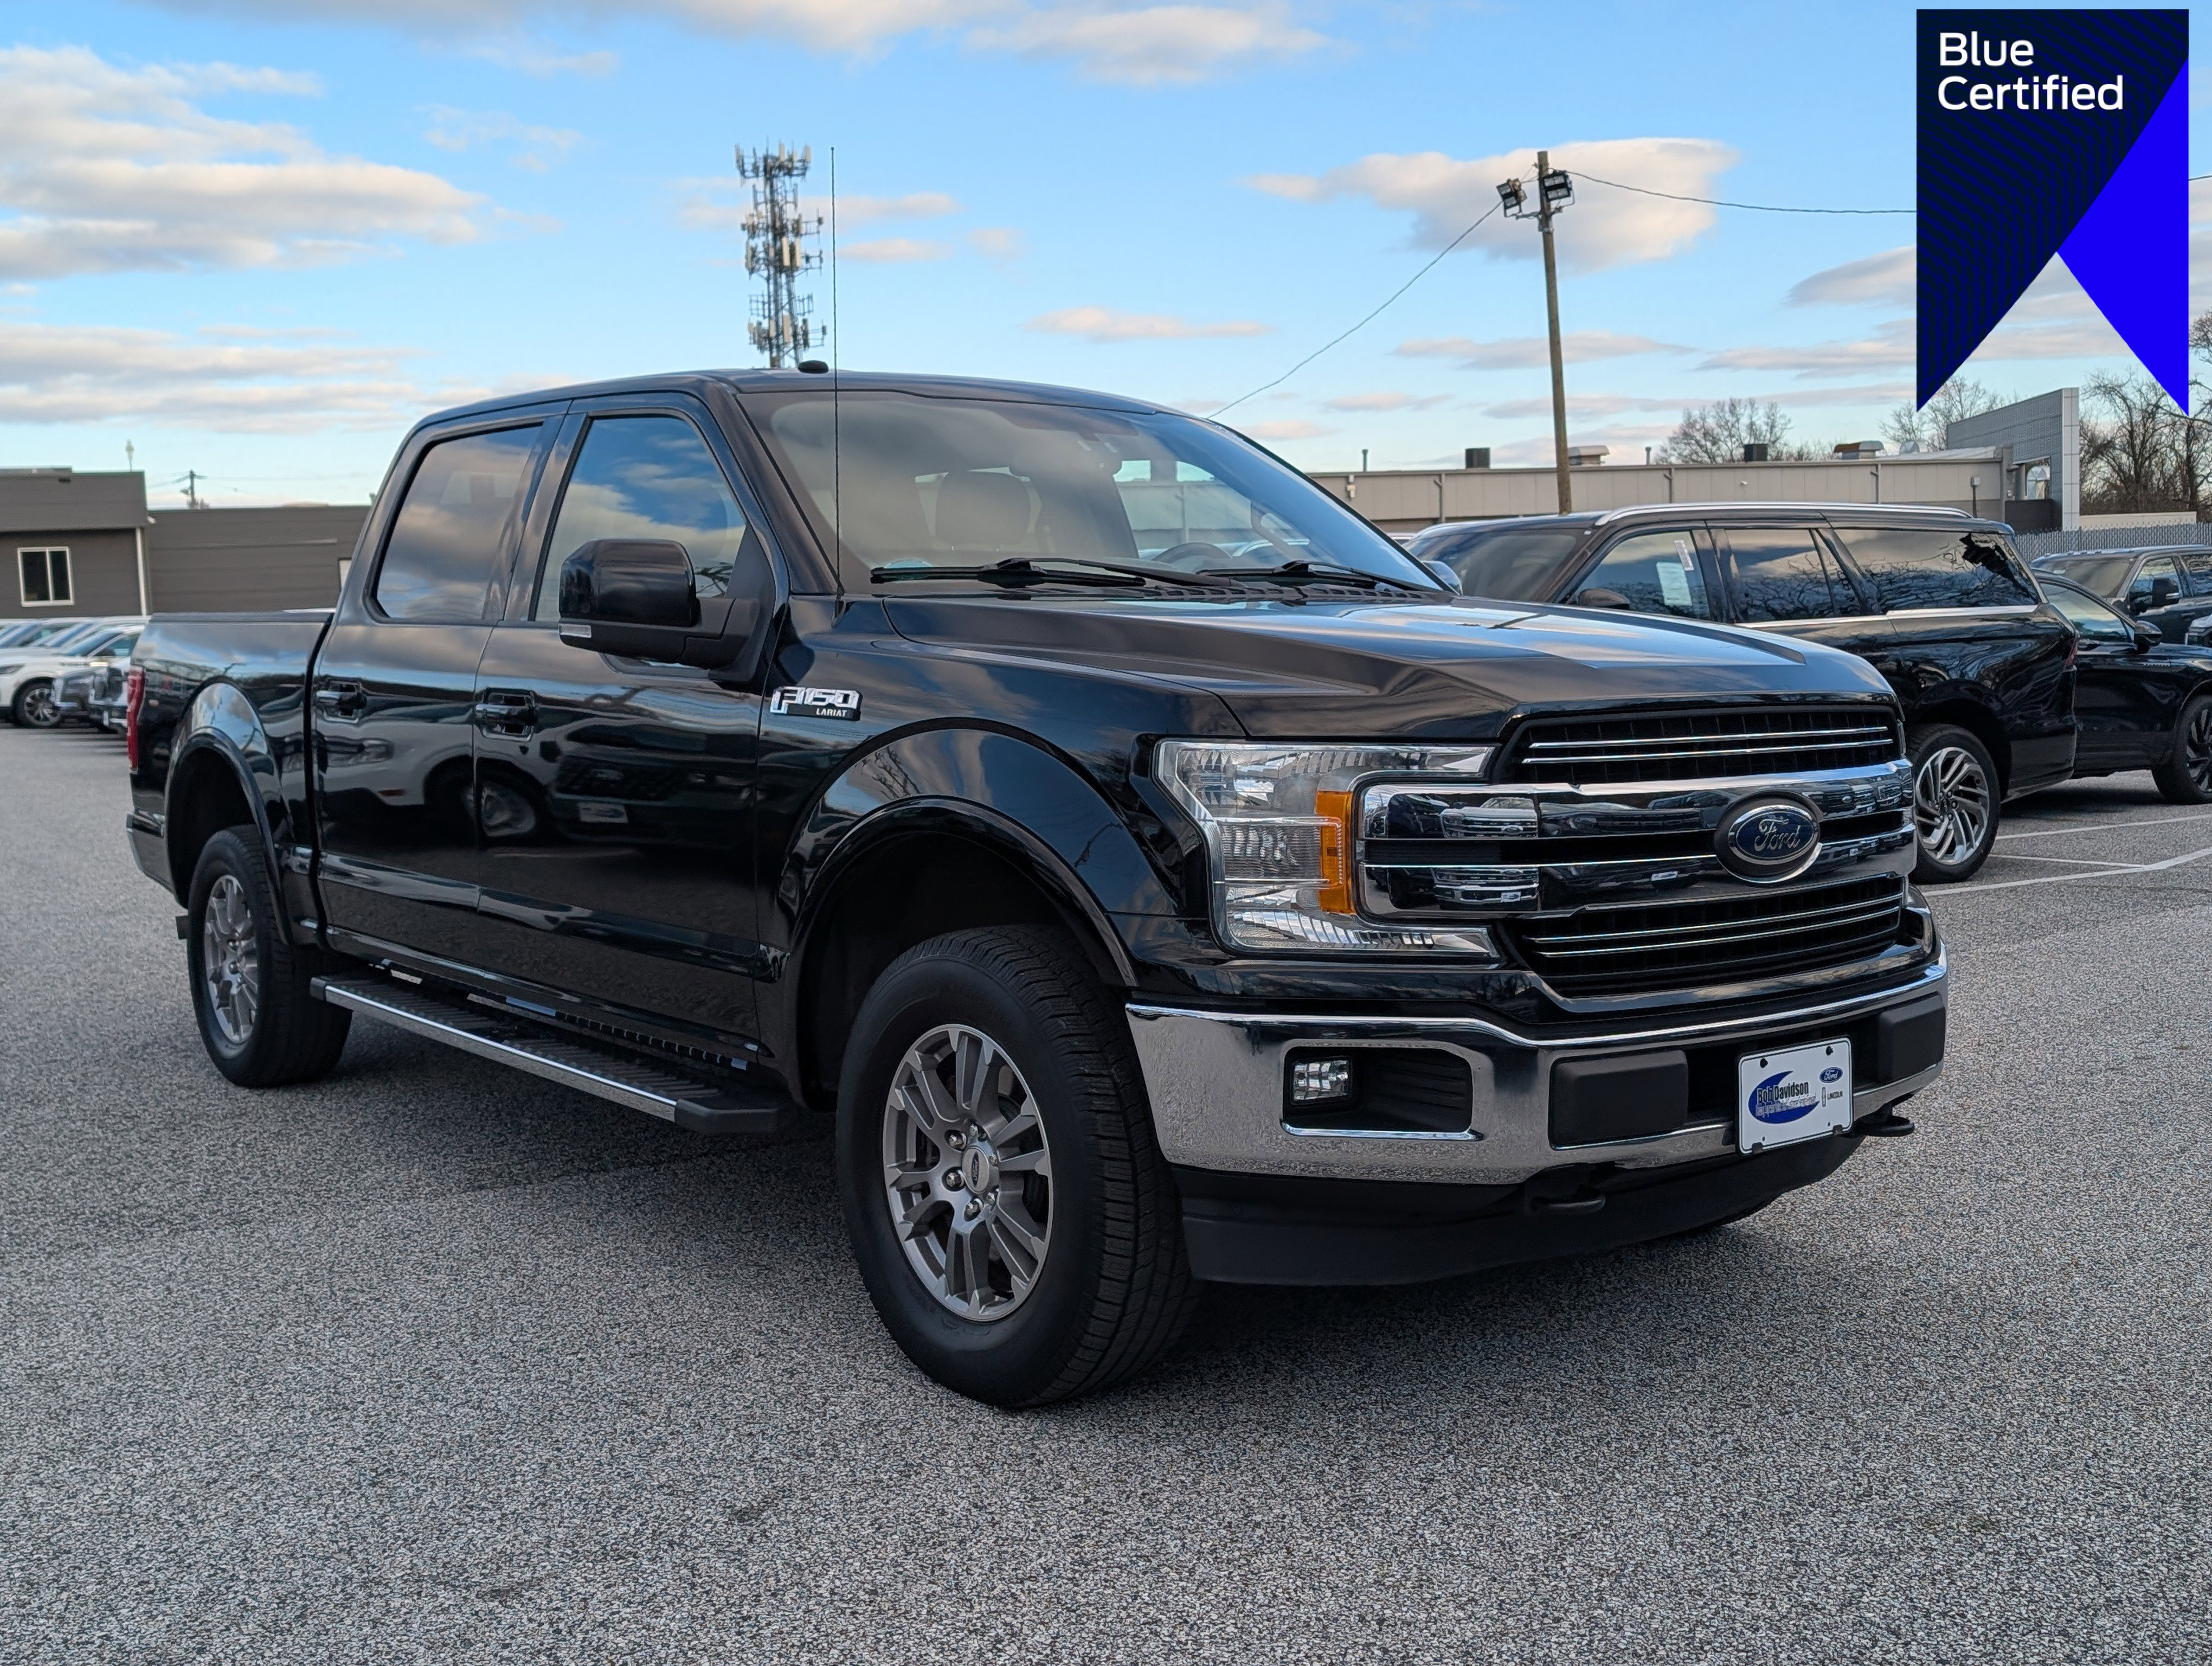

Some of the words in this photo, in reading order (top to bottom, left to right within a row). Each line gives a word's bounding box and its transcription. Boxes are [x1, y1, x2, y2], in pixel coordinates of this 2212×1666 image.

[816, 708, 847, 717] LARIAT
[1754, 818, 1801, 851] Ford
[1824, 1069, 1839, 1081] Ford
[1758, 1087, 1773, 1104] Bob
[1774, 1081, 1809, 1100] Davidson
